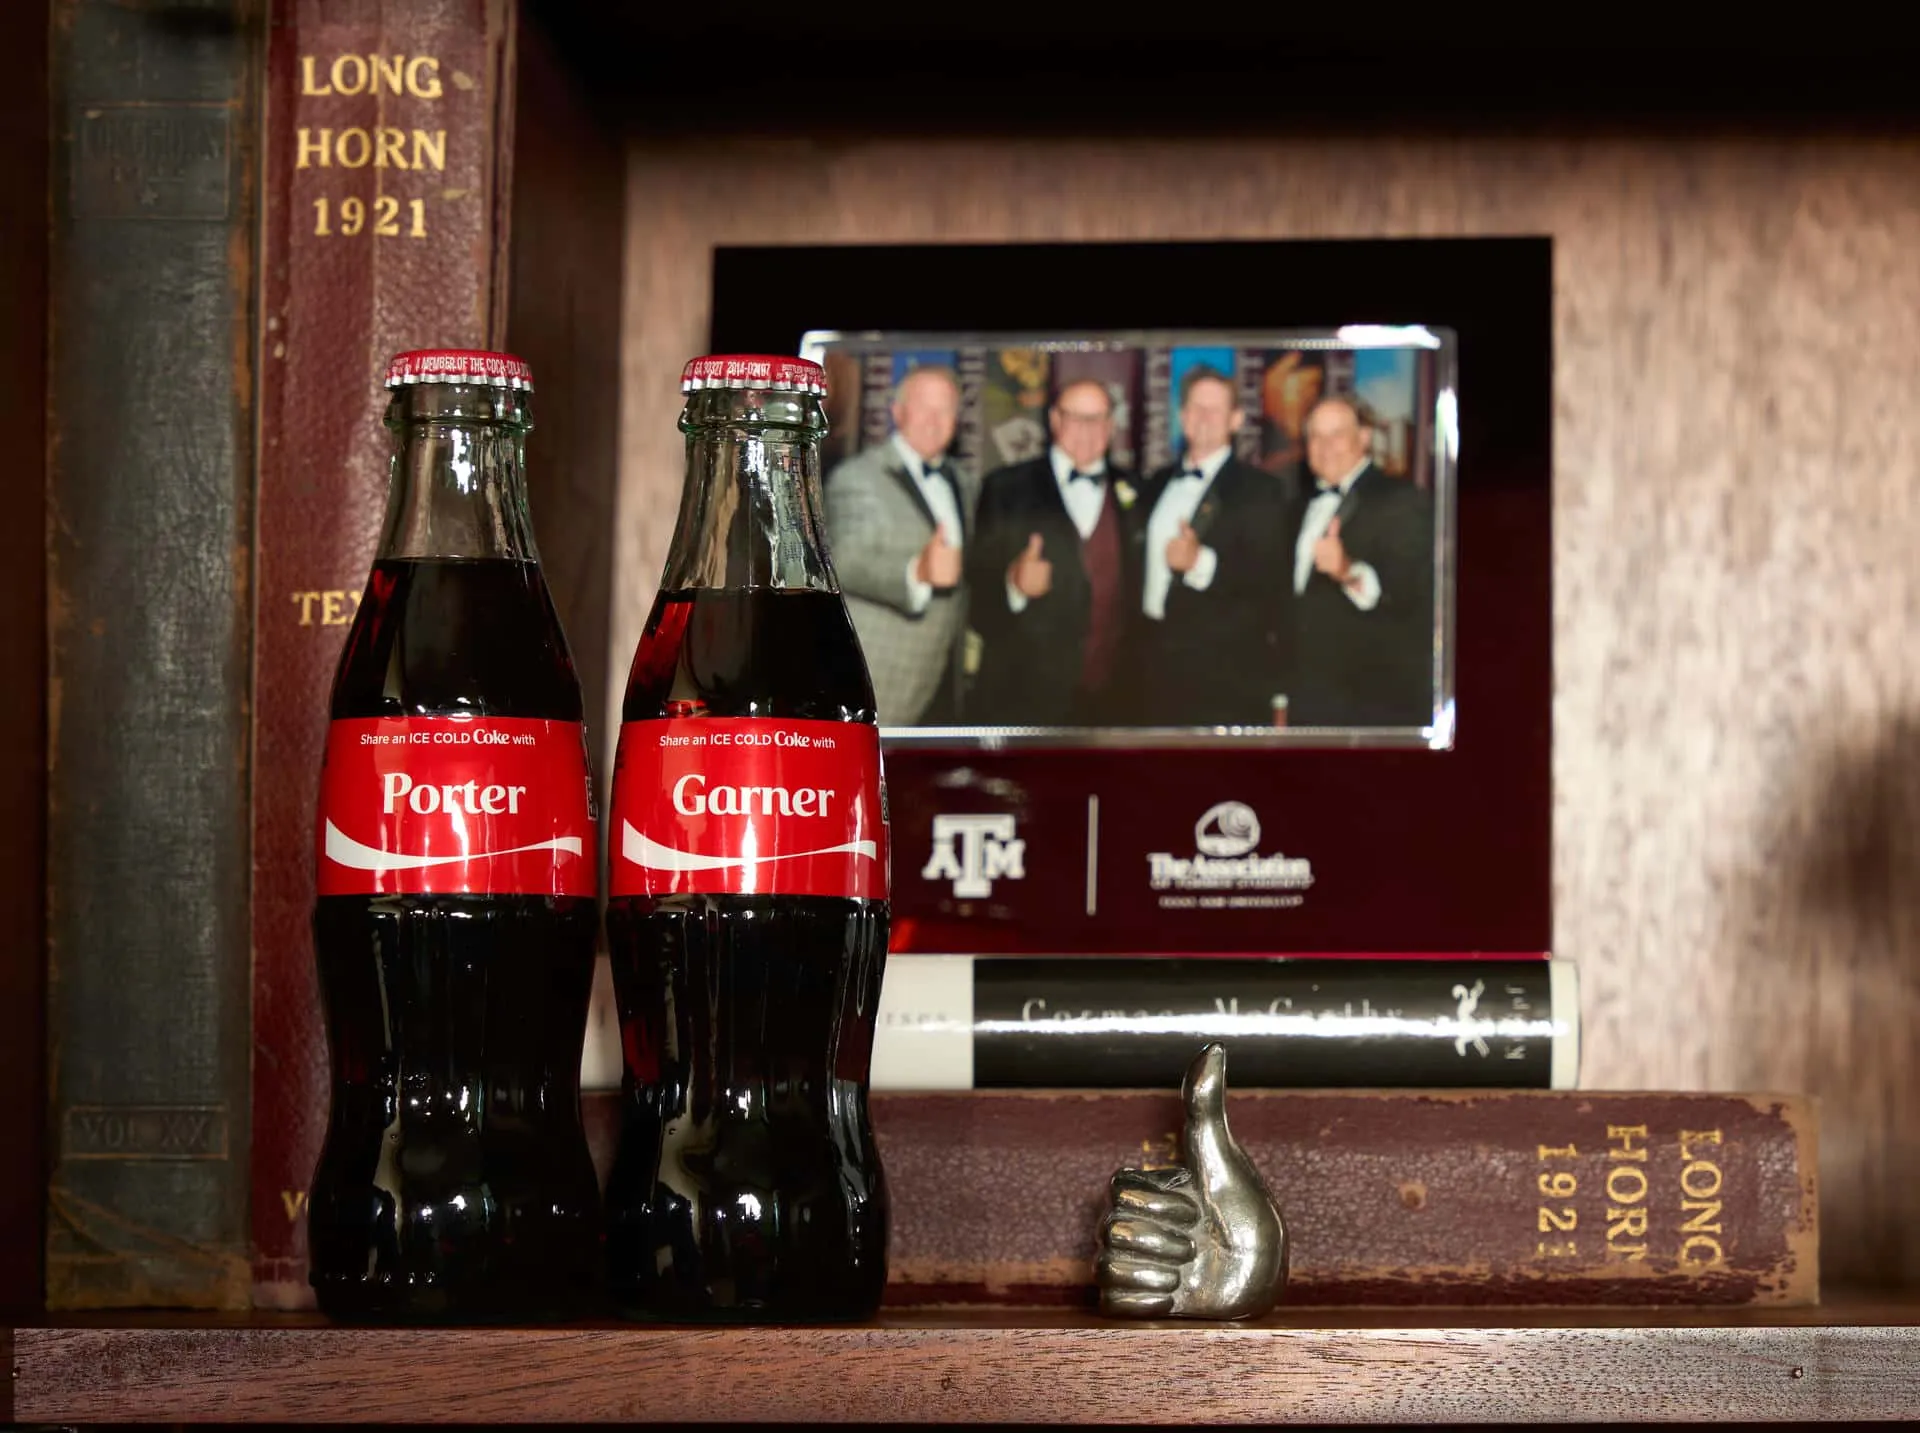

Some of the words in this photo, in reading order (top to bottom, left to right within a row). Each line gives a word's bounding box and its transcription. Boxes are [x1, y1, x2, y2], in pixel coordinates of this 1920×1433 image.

[302, 54, 443, 99] LONG
[296, 127, 446, 171] HORN
[312, 196, 427, 238] 1921
[470, 357, 484, 373] THE
[360, 733, 390, 746] Share
[391, 735, 406, 745] an
[409, 732, 430, 745] ICE
[433, 732, 471, 745] COLD
[472, 729, 510, 746] Coke
[512, 733, 536, 746] with
[659, 735, 690, 748] Share
[691, 736, 707, 746] an
[710, 733, 731, 746] ICE
[734, 733, 772, 746] COLD
[773, 730, 810, 748] Coke
[812, 736, 836, 749] with
[382, 772, 526, 815] Porter
[673, 773, 835, 817] Garner
[1678, 1129, 1723, 1268] LONG
